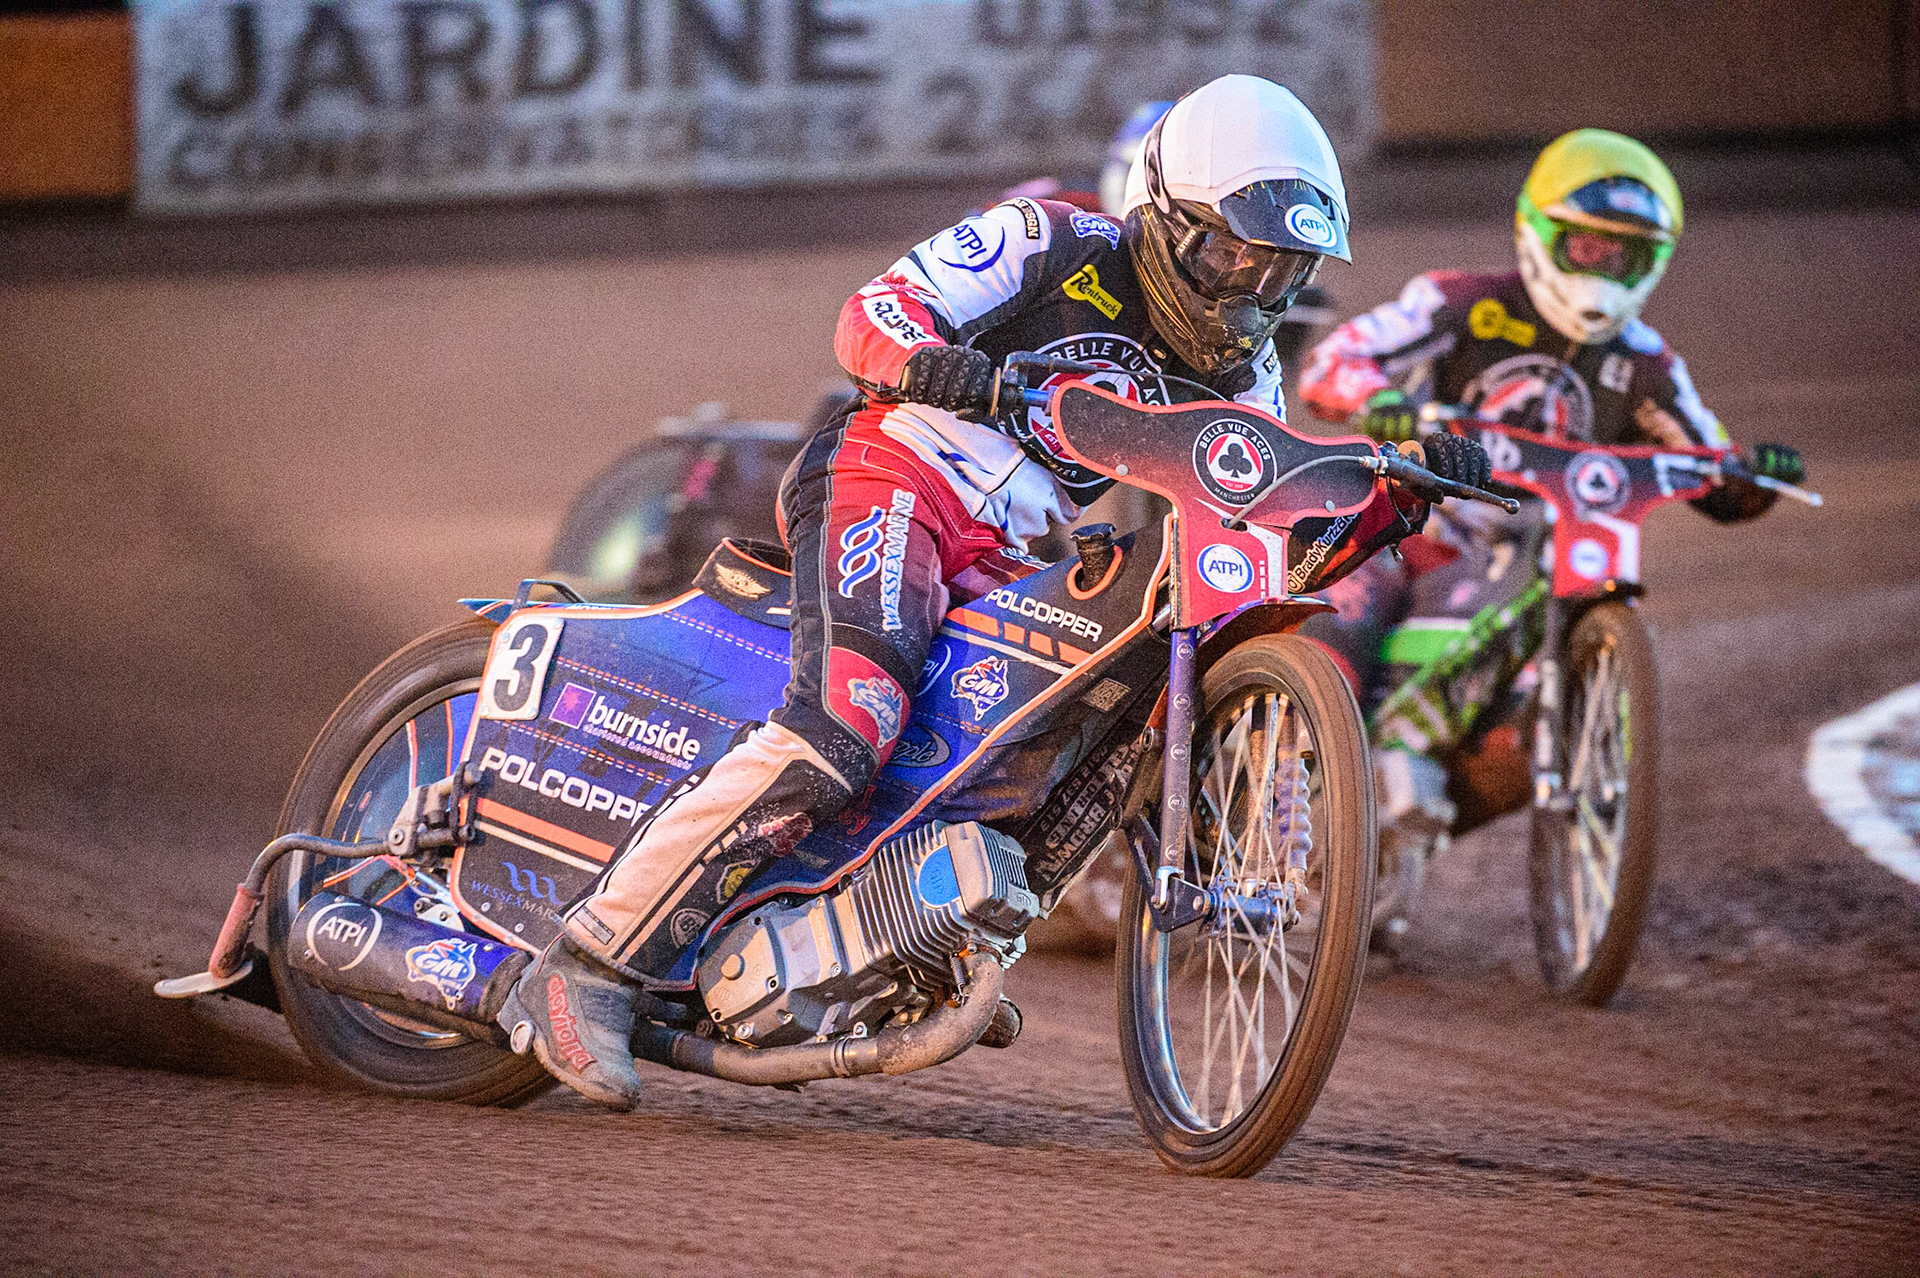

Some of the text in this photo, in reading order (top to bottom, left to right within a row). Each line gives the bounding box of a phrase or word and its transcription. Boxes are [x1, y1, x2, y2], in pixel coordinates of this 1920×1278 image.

[172, 0, 884, 116] JARDINE
[951, 223, 988, 260] ATPI
[1300, 218, 1326, 233] ATPI
[1070, 270, 1118, 315] Rentruck
[1199, 423, 1271, 460] BELLE VUE ACES
[884, 490, 914, 628] WESSEXMARNE
[1208, 559, 1243, 578] ATPI
[984, 588, 1103, 642] POLCOPPER
[493, 624, 549, 712] 3
[922, 658, 939, 680] PI
[959, 674, 1001, 696] GM
[587, 695, 701, 760] burnside
[478, 746, 652, 820] POLCOPP
[317, 916, 367, 947] ATPI
[415, 953, 466, 979] GM
